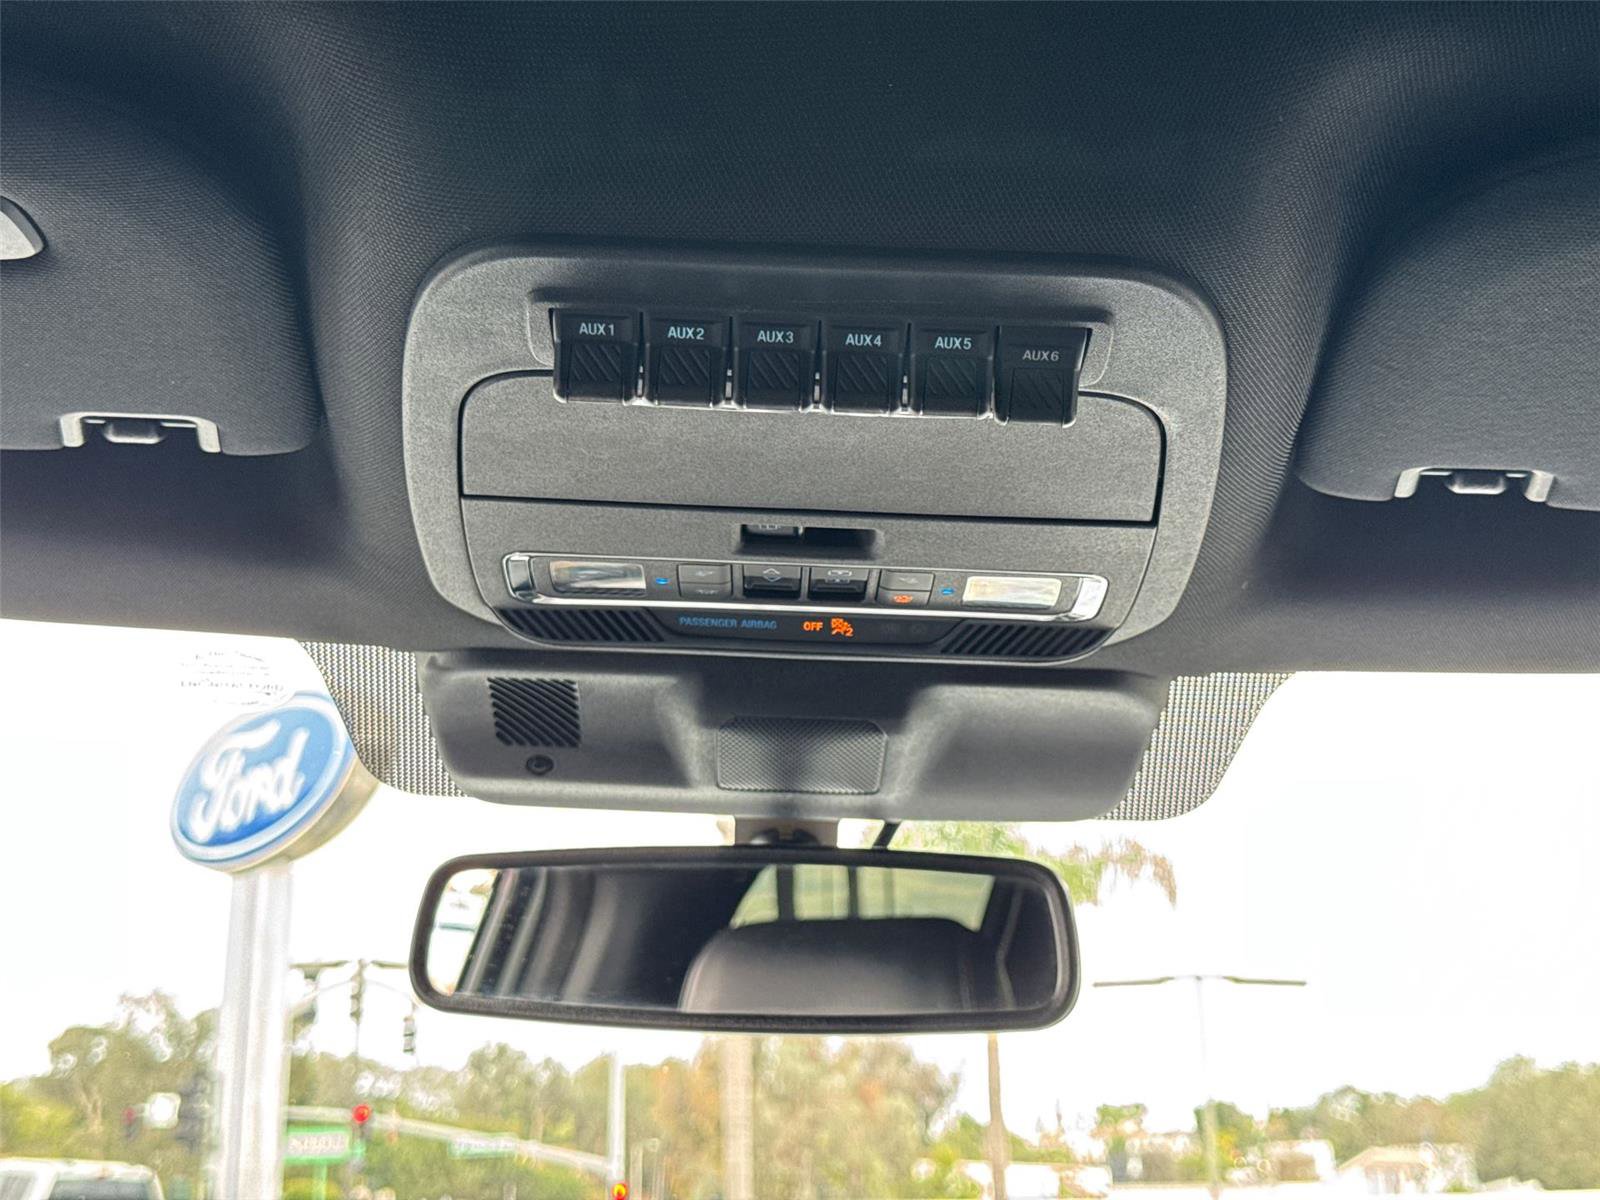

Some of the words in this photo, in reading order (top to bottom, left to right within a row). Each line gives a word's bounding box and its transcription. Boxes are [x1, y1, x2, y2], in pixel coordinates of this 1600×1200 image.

[579, 322, 616, 336] AUX1
[667, 326, 705, 341] AUX2
[756, 329, 794, 344] AUX3
[845, 333, 882, 347] AUX4
[934, 336, 972, 350] AUX5
[1021, 349, 1060, 362] AUX6
[678, 616, 738, 629] PASSENGER
[740, 619, 778, 631] AIRBAG
[802, 620, 824, 632] OFF
[187, 717, 311, 843] Ford
